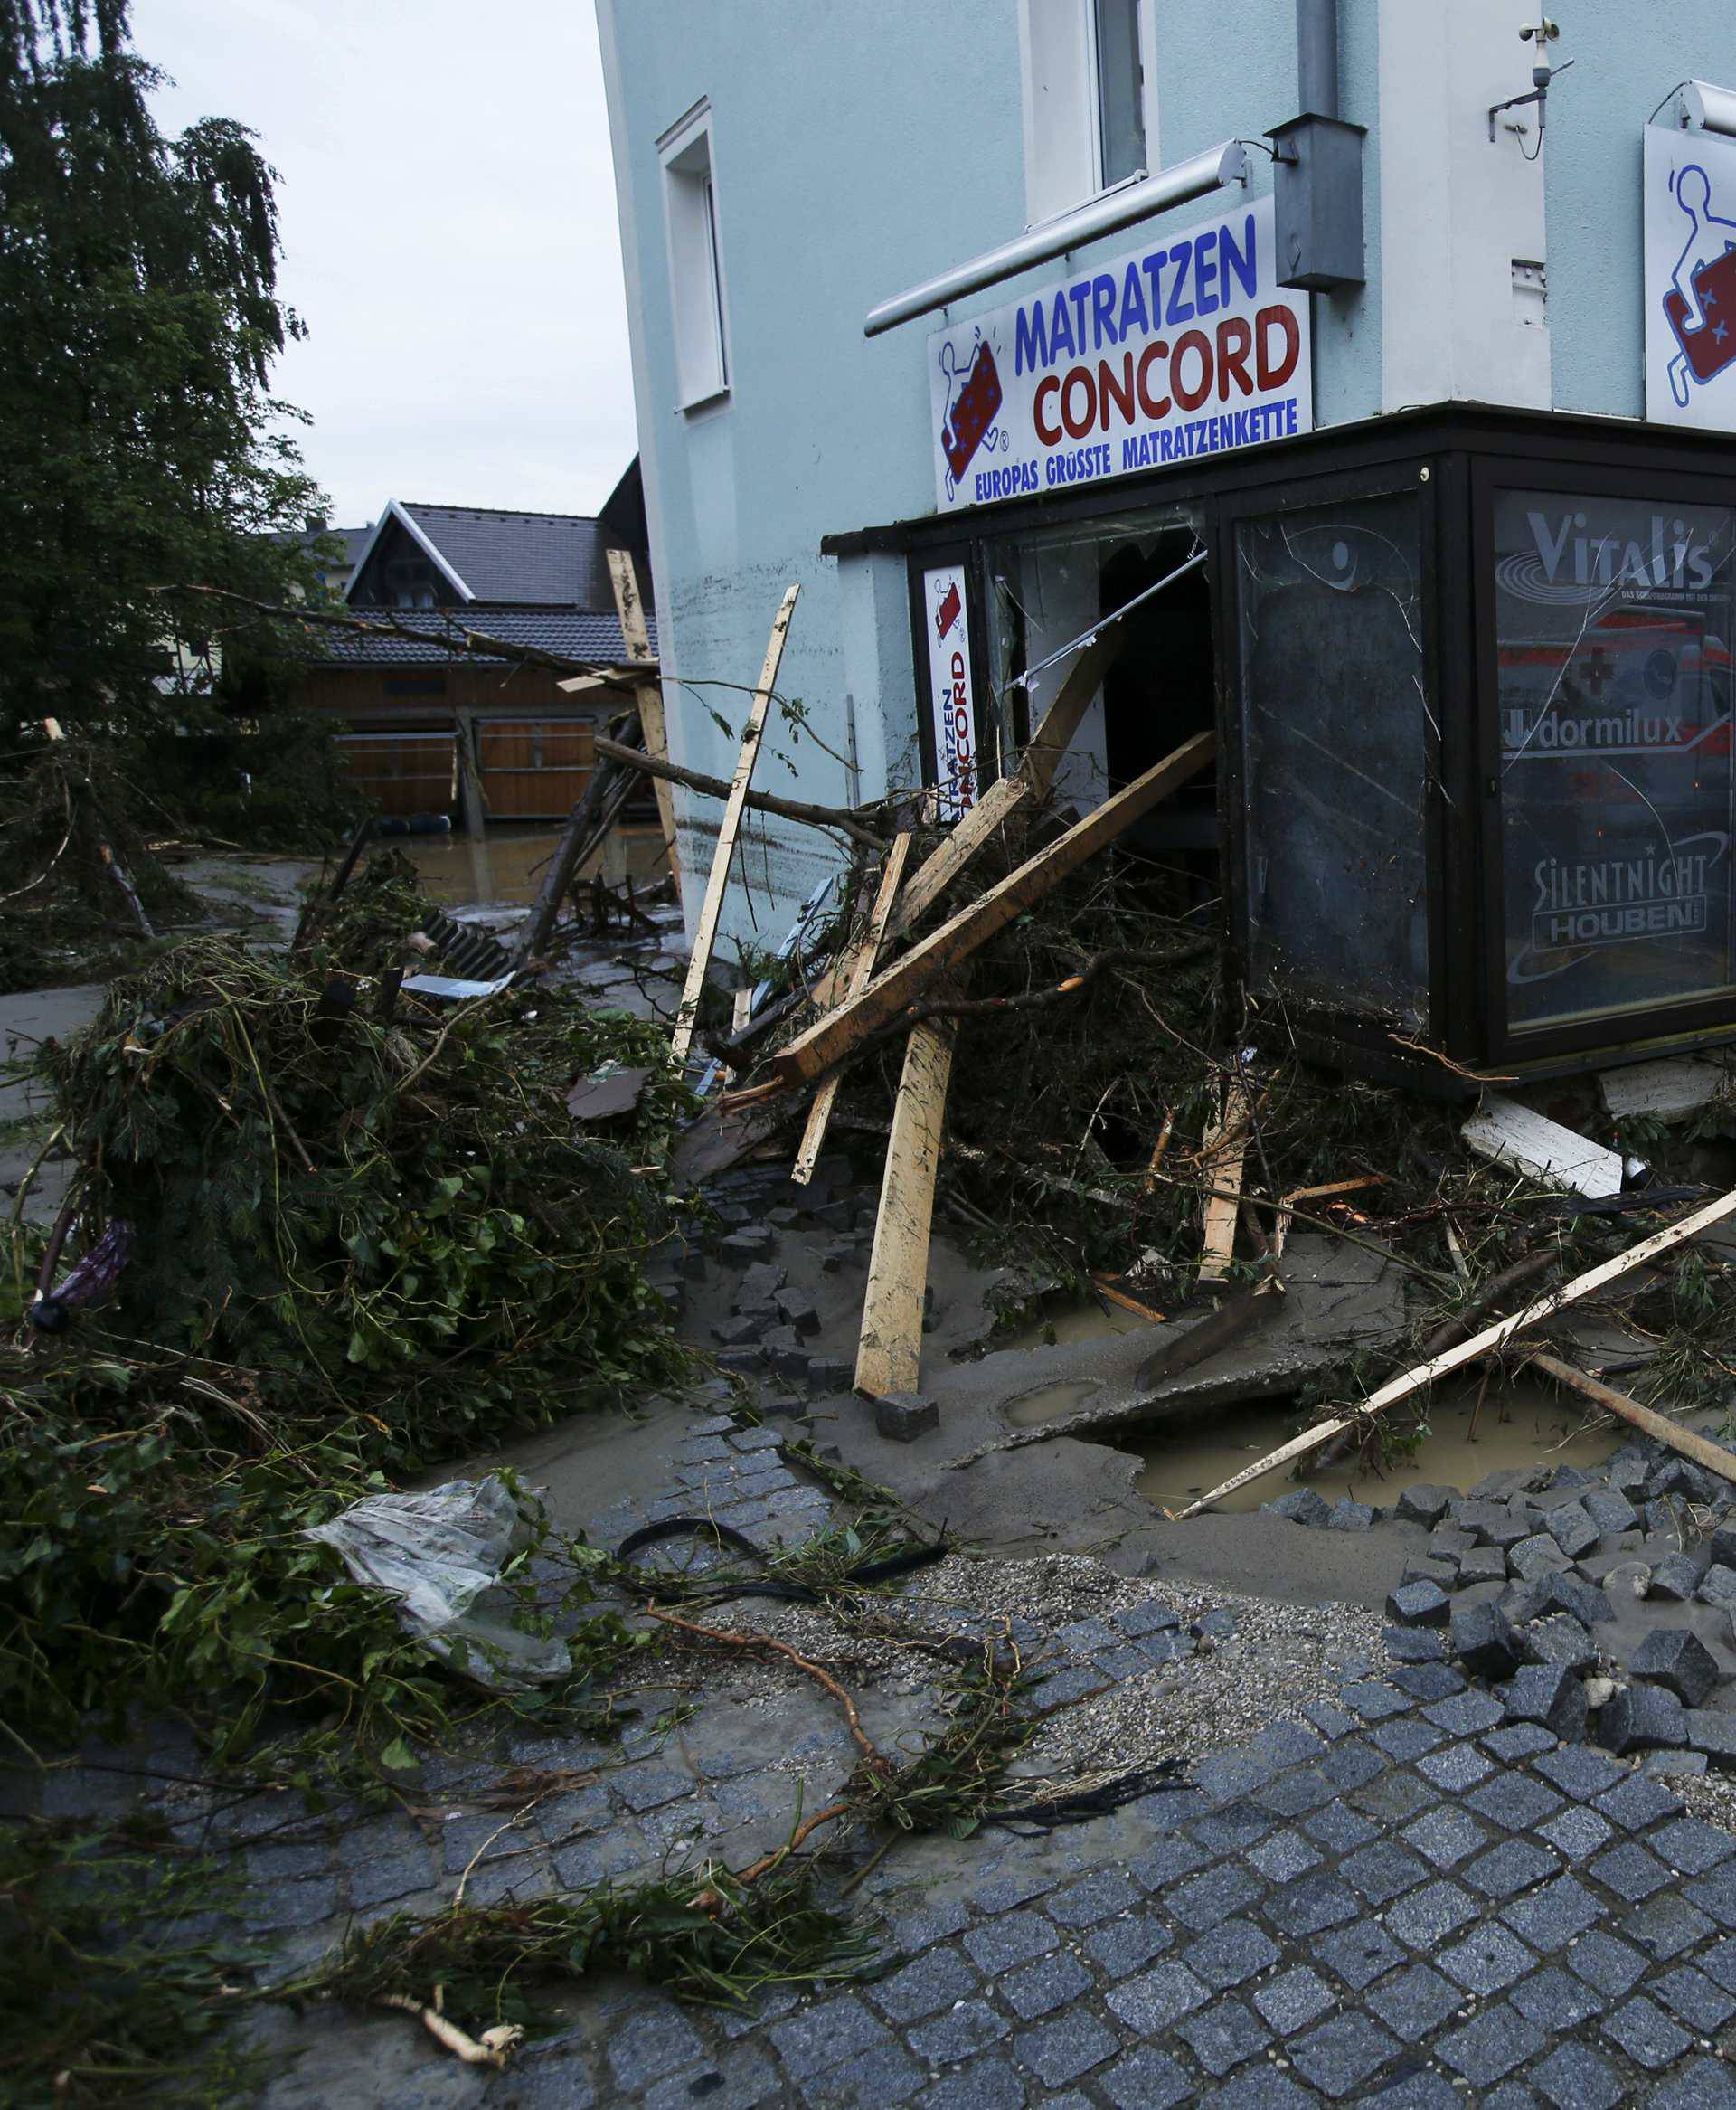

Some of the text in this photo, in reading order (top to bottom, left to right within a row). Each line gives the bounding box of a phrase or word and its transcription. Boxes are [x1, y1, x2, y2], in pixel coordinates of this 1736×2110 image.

[1015, 214, 1257, 376] MATRATZEN
[1033, 304, 1300, 447] CONCORD
[976, 398, 1297, 502] EUROPAS GRÖSSTE MATRATZENKETTE
[951, 650, 974, 818] ONCORD
[1539, 709, 1683, 748] dormilux
[1551, 903, 1692, 942] HOUBEN
